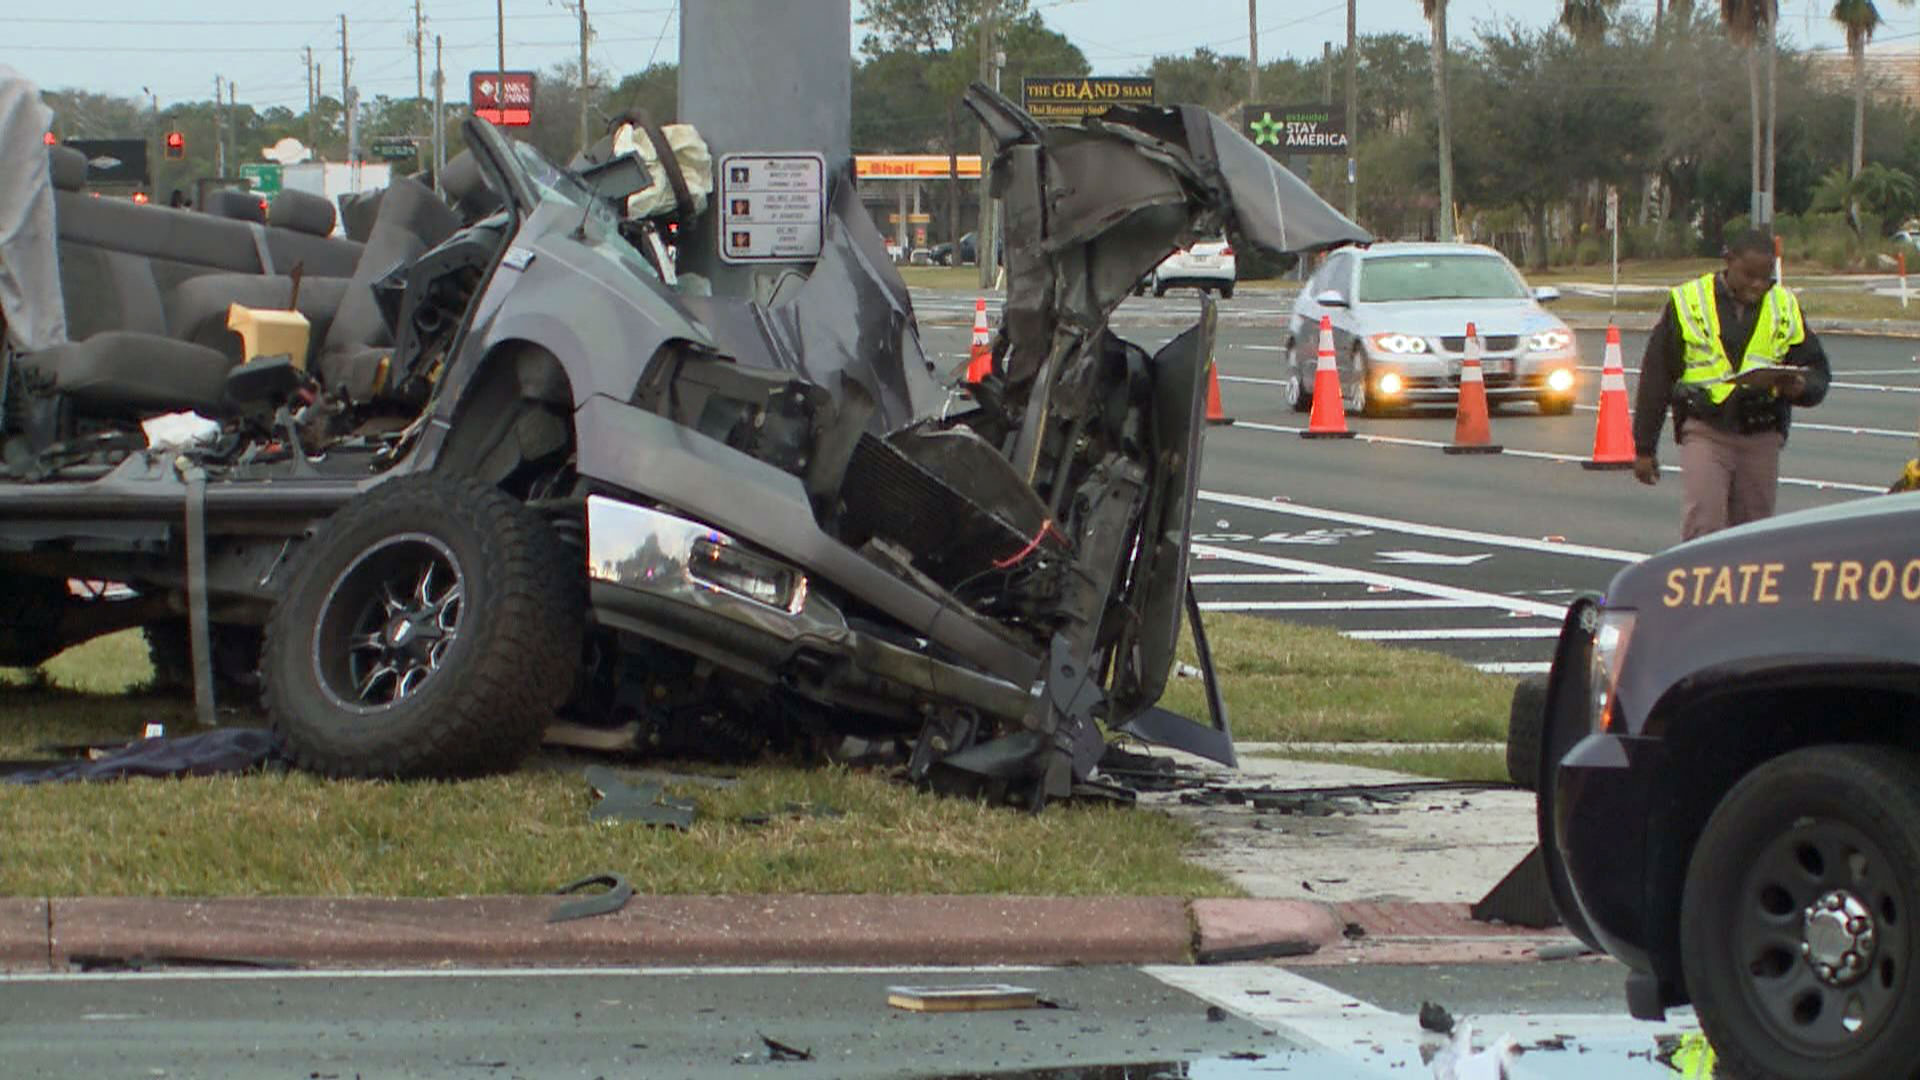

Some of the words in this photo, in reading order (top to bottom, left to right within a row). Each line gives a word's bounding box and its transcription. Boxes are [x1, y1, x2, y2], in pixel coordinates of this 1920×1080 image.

[1027, 85, 1050, 97] THE
[1052, 80, 1120, 99] GRAND
[1121, 85, 1153, 97] SIAM
[1027, 103, 1045, 114] Thai
[1286, 113, 1328, 121] extended
[1286, 121, 1318, 134] STAY
[1286, 133, 1348, 146] AMERICA
[869, 161, 915, 174] Shell
[1662, 562, 1785, 607] STATE
